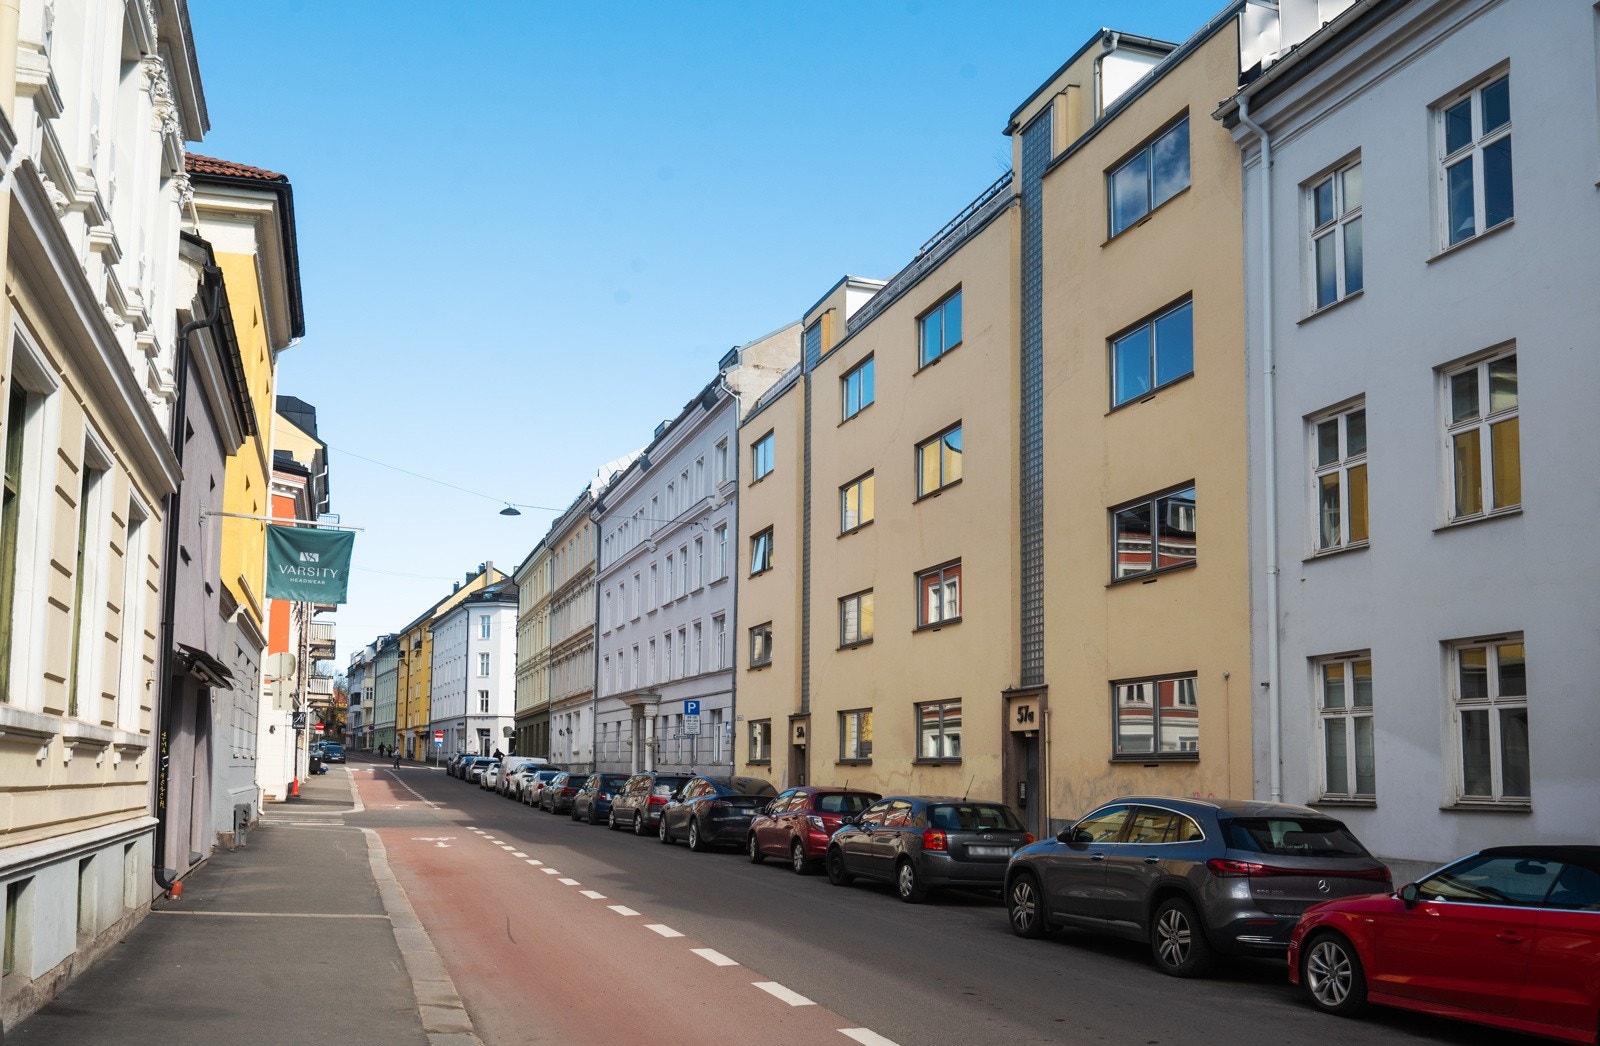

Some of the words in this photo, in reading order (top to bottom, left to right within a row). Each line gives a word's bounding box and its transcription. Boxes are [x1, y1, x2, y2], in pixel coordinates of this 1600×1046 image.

[278, 564, 339, 579] VARSITY
[289, 577, 326, 585] HEADWEAR
[687, 702, 697, 714] P
